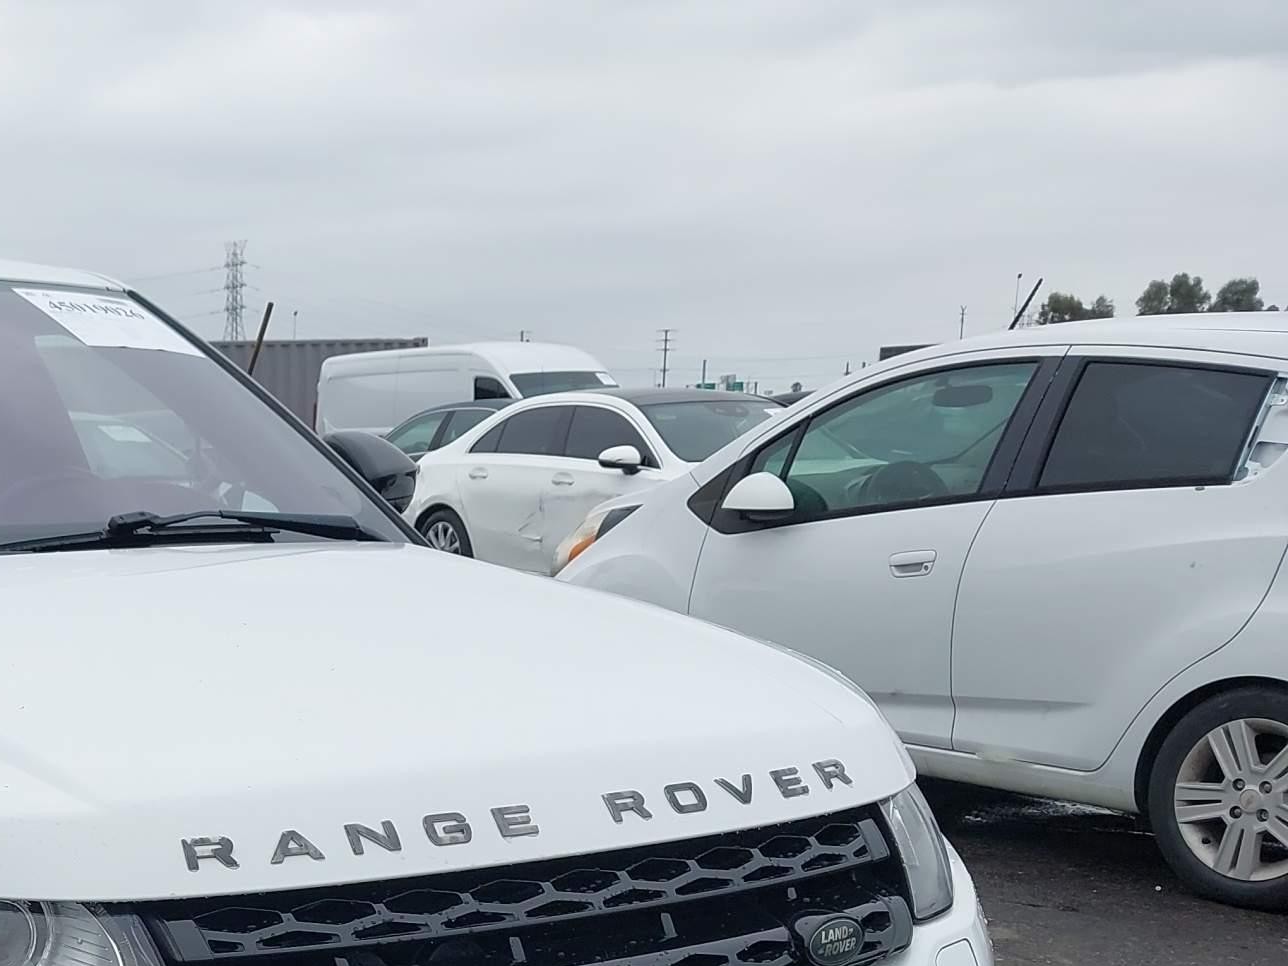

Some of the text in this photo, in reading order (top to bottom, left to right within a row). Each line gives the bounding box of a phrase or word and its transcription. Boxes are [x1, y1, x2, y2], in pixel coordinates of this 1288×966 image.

[181, 758, 854, 871] RANGE ROVER
[821, 926, 849, 944] LAND
[824, 938, 856, 956] ROVER
